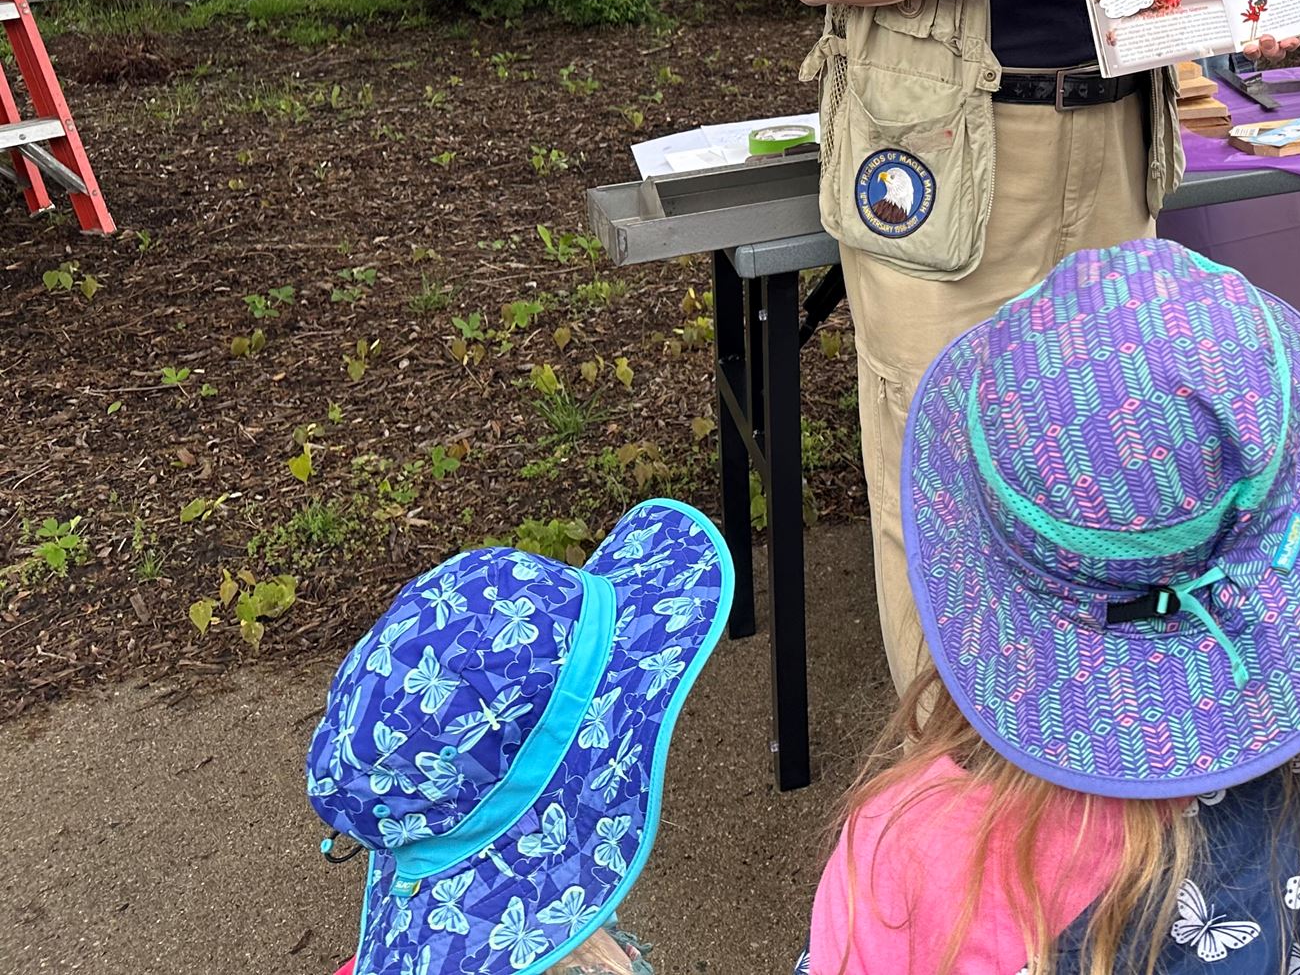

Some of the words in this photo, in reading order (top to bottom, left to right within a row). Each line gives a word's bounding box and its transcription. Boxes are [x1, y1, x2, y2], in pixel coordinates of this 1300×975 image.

[861, 155, 886, 186] FRIENDS
[887, 153, 896, 161] OF
[920, 179, 932, 213] MARSH
